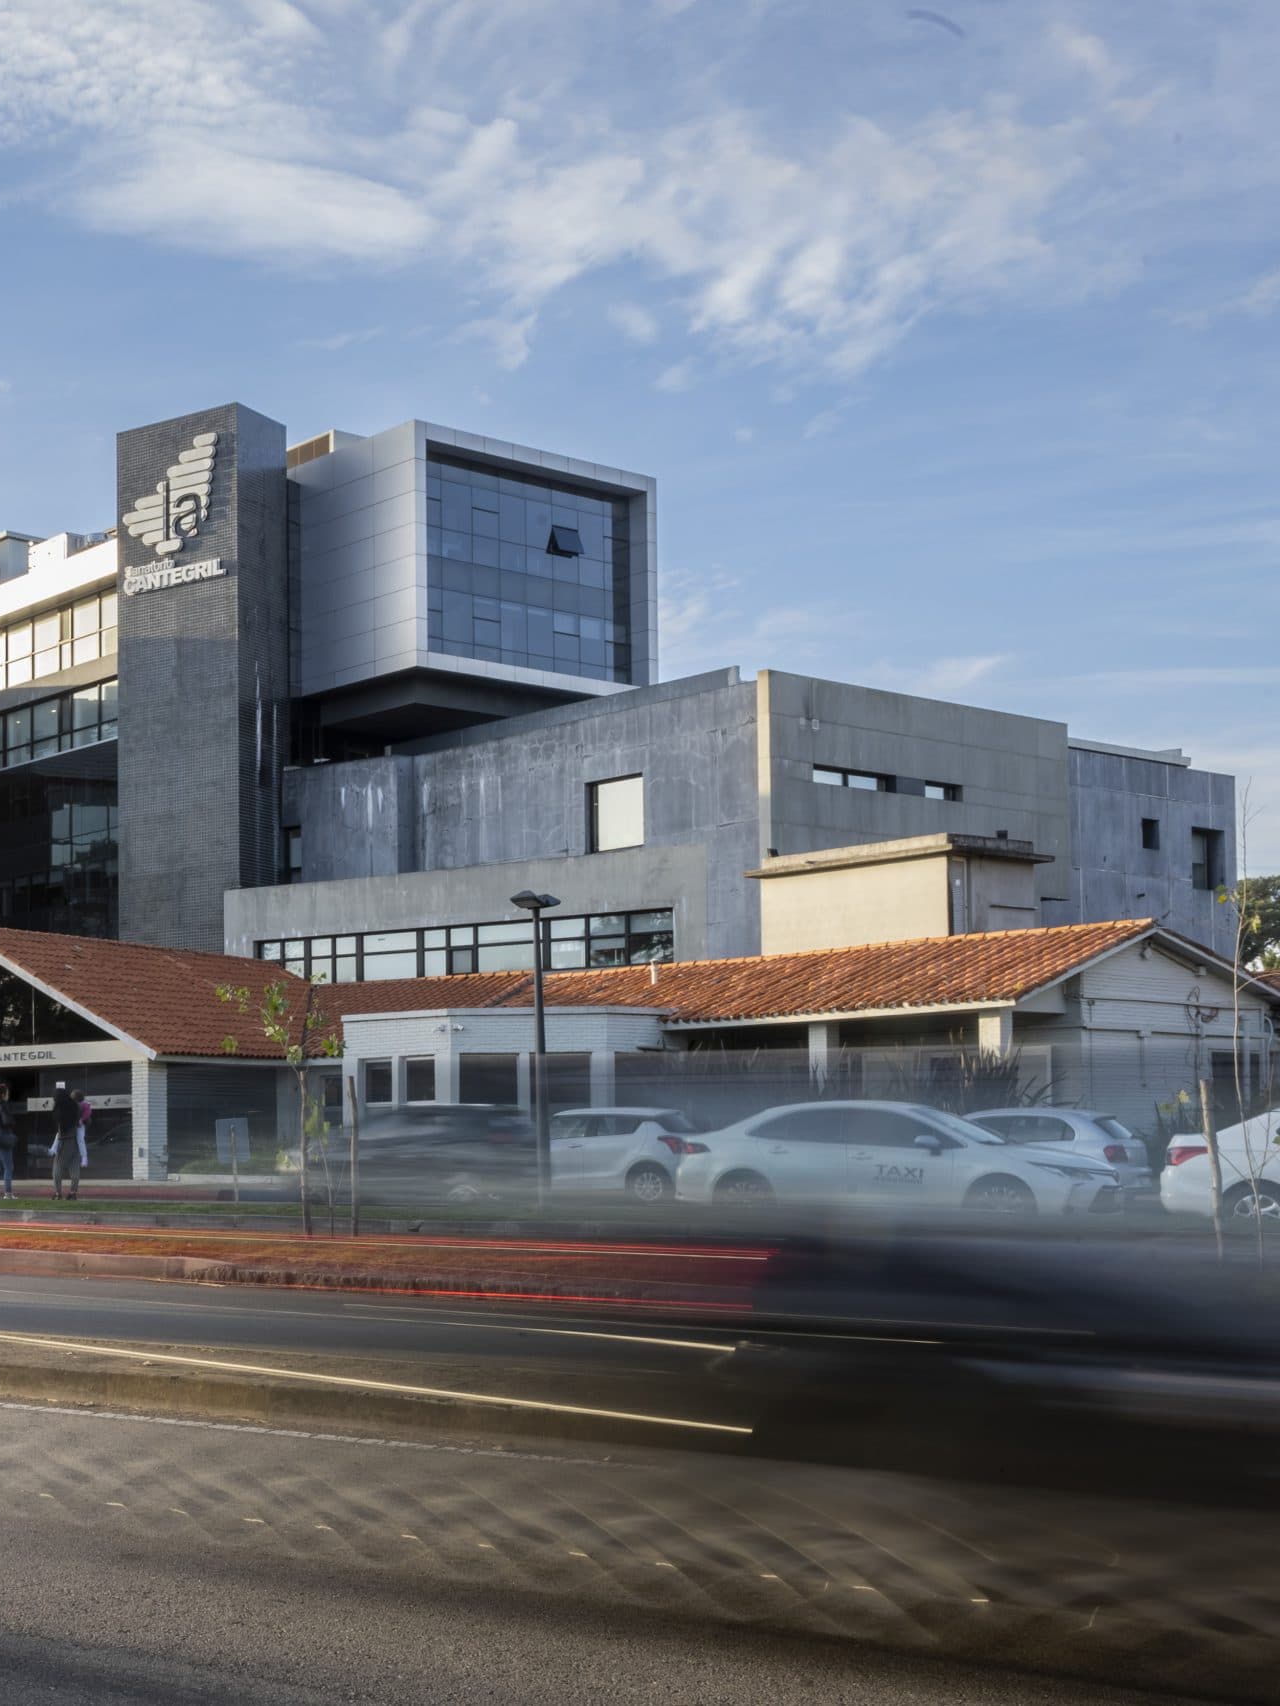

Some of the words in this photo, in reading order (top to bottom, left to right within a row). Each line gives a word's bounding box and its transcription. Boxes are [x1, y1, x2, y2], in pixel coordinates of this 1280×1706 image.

[124, 558, 223, 595] CANTEGRIL
[125, 558, 175, 578] Sanatorio
[875, 1164, 924, 1178] TAXI
